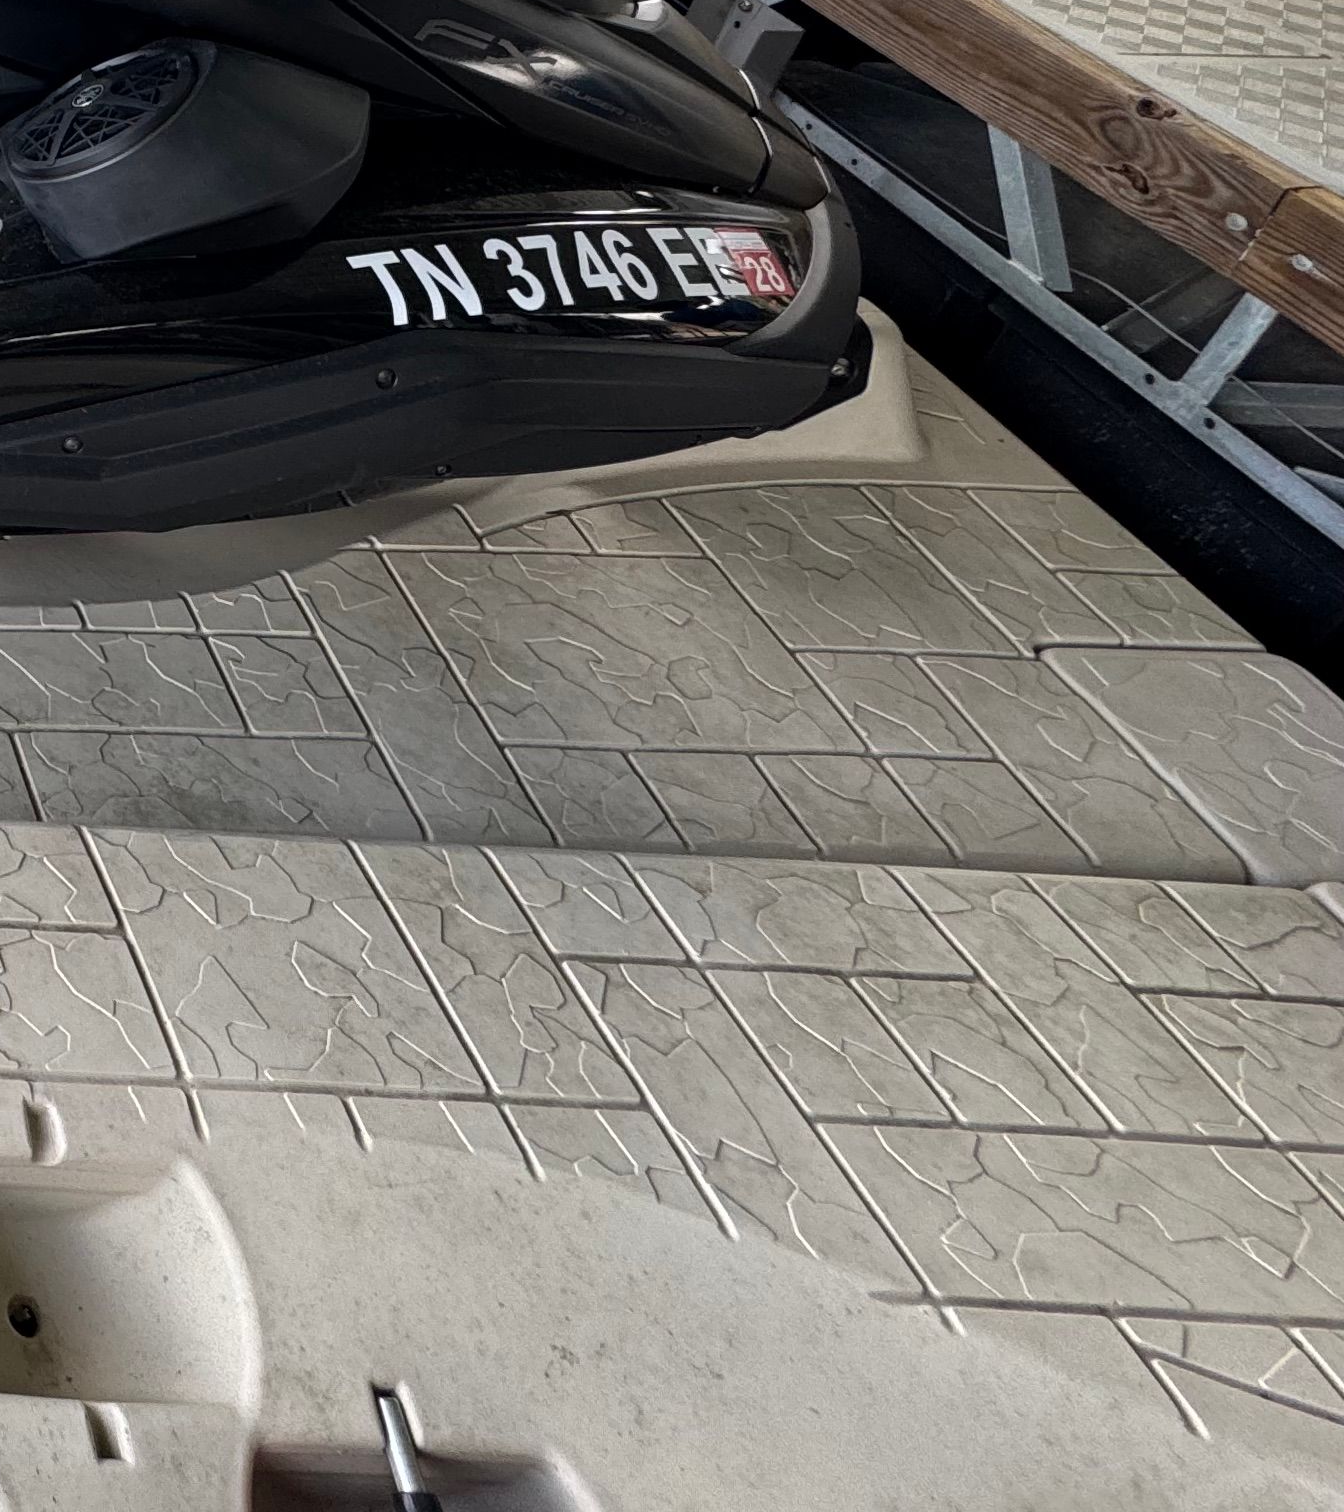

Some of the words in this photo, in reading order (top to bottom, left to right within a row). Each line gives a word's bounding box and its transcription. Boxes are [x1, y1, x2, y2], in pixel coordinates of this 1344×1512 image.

[413, 17, 558, 85] FX
[346, 243, 484, 327] TN
[482, 228, 659, 312] 3746
[743, 255, 786, 293] 28
